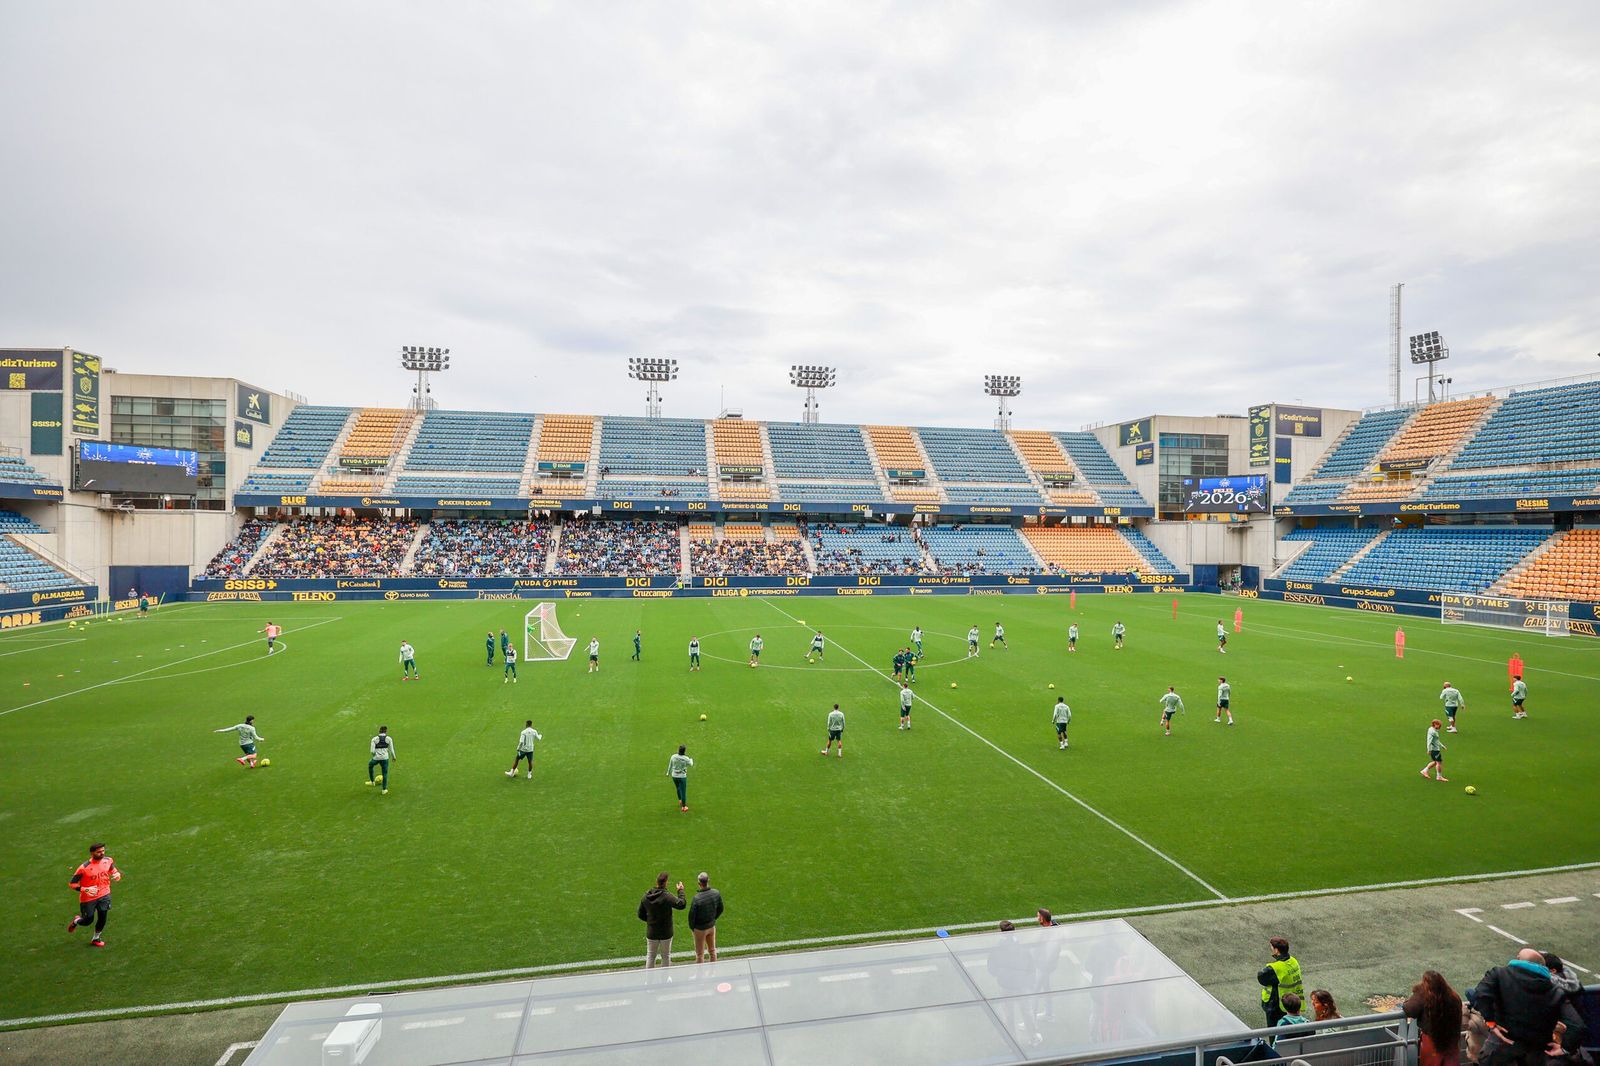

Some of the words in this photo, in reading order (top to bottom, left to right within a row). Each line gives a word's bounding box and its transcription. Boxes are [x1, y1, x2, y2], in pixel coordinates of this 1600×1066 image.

[281, 496, 306, 504] SLICE
[1200, 492, 1246, 504] 2026
[613, 501, 633, 509] DIGI
[688, 502, 707, 510] DIGI
[783, 503, 801, 511] DIGI
[1400, 502, 1460, 511] @CadizTurismo
[626, 577, 651, 587] DIGI
[704, 577, 728, 586] DIGI
[786, 577, 810, 586] DIGI
[858, 576, 880, 585] DIGI
[1141, 575, 1167, 583] asisa
[225, 580, 265, 590] asisa
[208, 592, 238, 600] GALAXY
[239, 592, 260, 600] PARK
[292, 592, 336, 600] TELENO
[633, 589, 673, 598] Cruzcampo
[837, 588, 873, 596] Cruzcampo
[1342, 587, 1365, 596] Grupo
[1365, 589, 1388, 598] Solera
[1284, 592, 1325, 605] ESSENZIA
[1428, 595, 1460, 604] AYUDA
[1477, 599, 1509, 608] PYMES
[0, 611, 41, 628] ARDE
